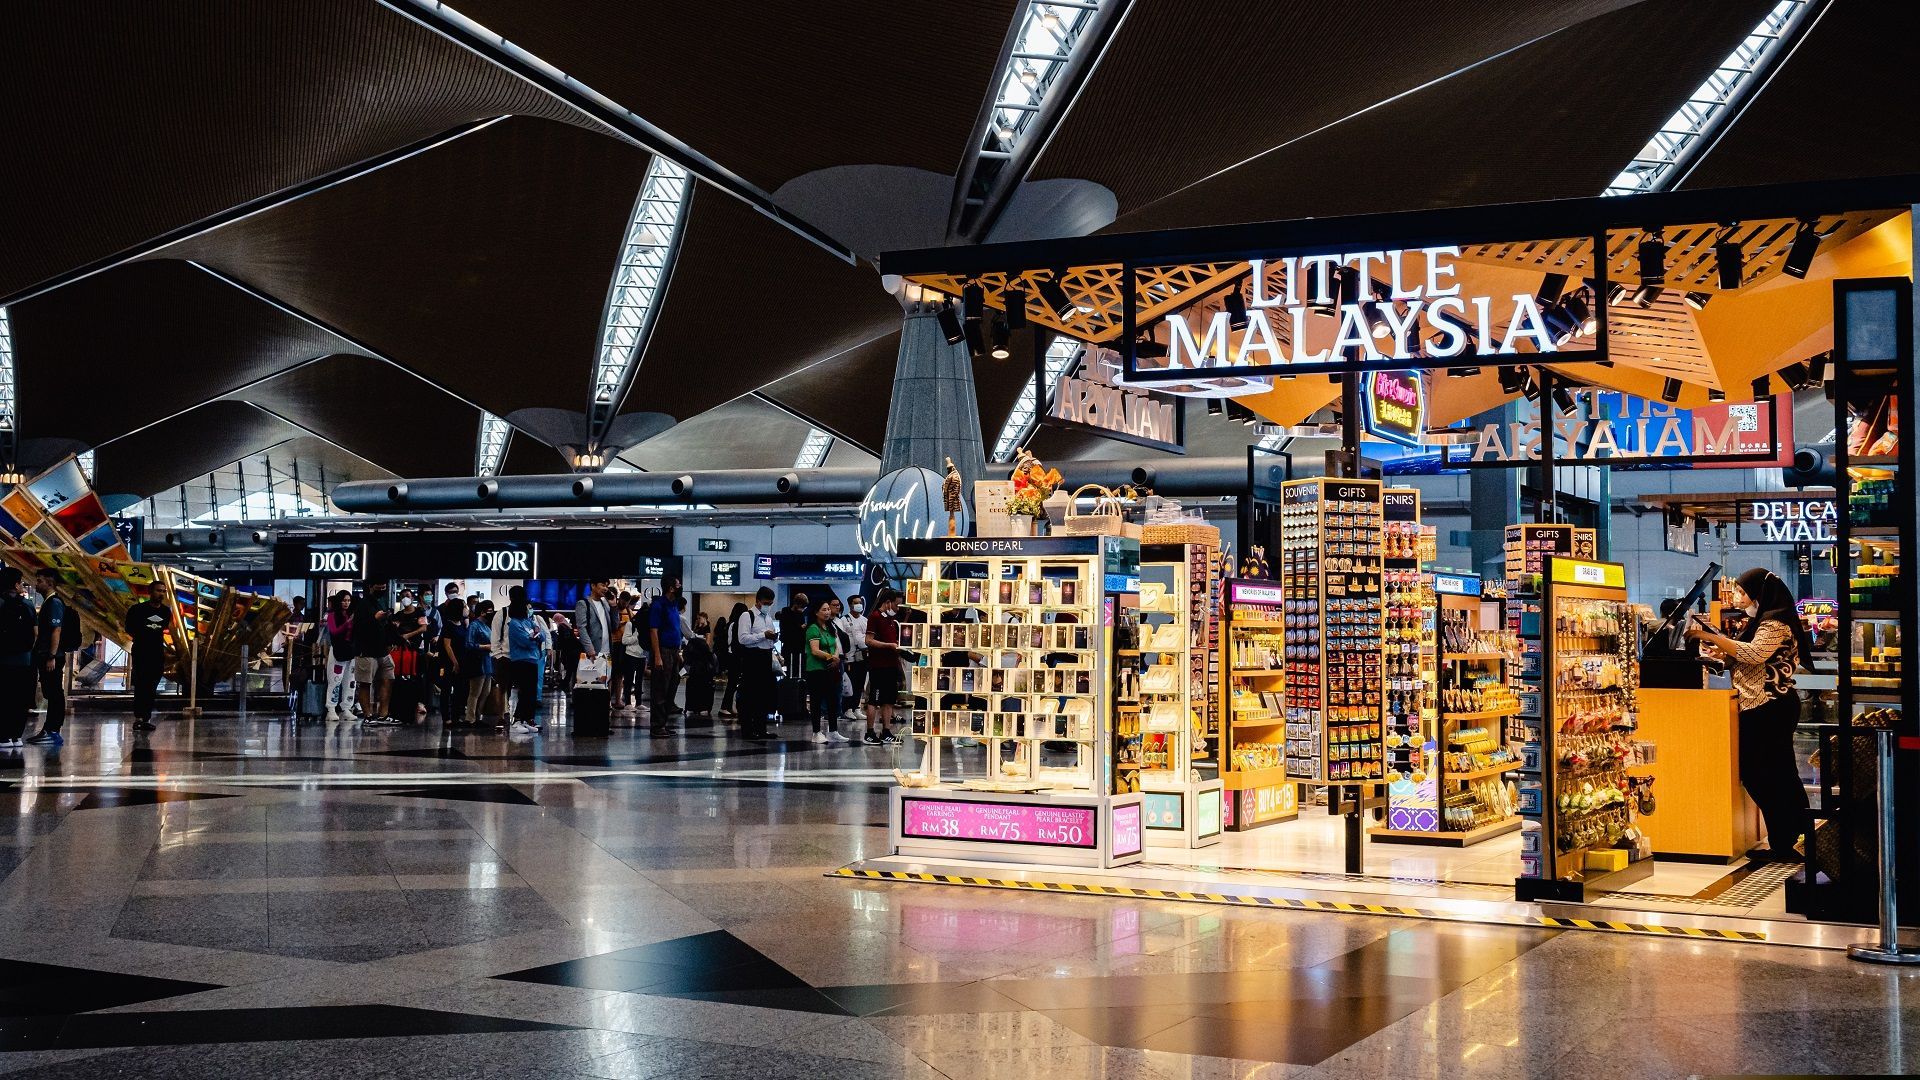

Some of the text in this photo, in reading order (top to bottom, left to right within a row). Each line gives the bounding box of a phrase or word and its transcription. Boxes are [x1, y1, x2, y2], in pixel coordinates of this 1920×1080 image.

[1249, 246, 1461, 307] LITTLE
[1165, 294, 1558, 369] MALAYSIA
[1285, 485, 1319, 498] SOUVENIRS
[1338, 487, 1366, 498] GIFTS
[859, 482, 918, 524] Around
[1752, 501, 1837, 520] DELICA
[1536, 530, 1559, 538] GIFTS
[1764, 519, 1837, 541] MAL
[945, 540, 1024, 551] BORNEO PEARL
[310, 552, 358, 572] DIOR
[476, 551, 528, 571] DIOR
[1804, 603, 1832, 614] Try Me
[1258, 789, 1270, 813] BUY
[926, 810, 955, 818] EARRINGS
[975, 807, 1020, 816] GENUINE PEARL
[984, 813, 1011, 821] PENDANT
[1034, 810, 1061, 818] GENUINE
[921, 818, 960, 837] RM38
[980, 822, 1021, 841] RM75
[1038, 825, 1082, 844] RM50
